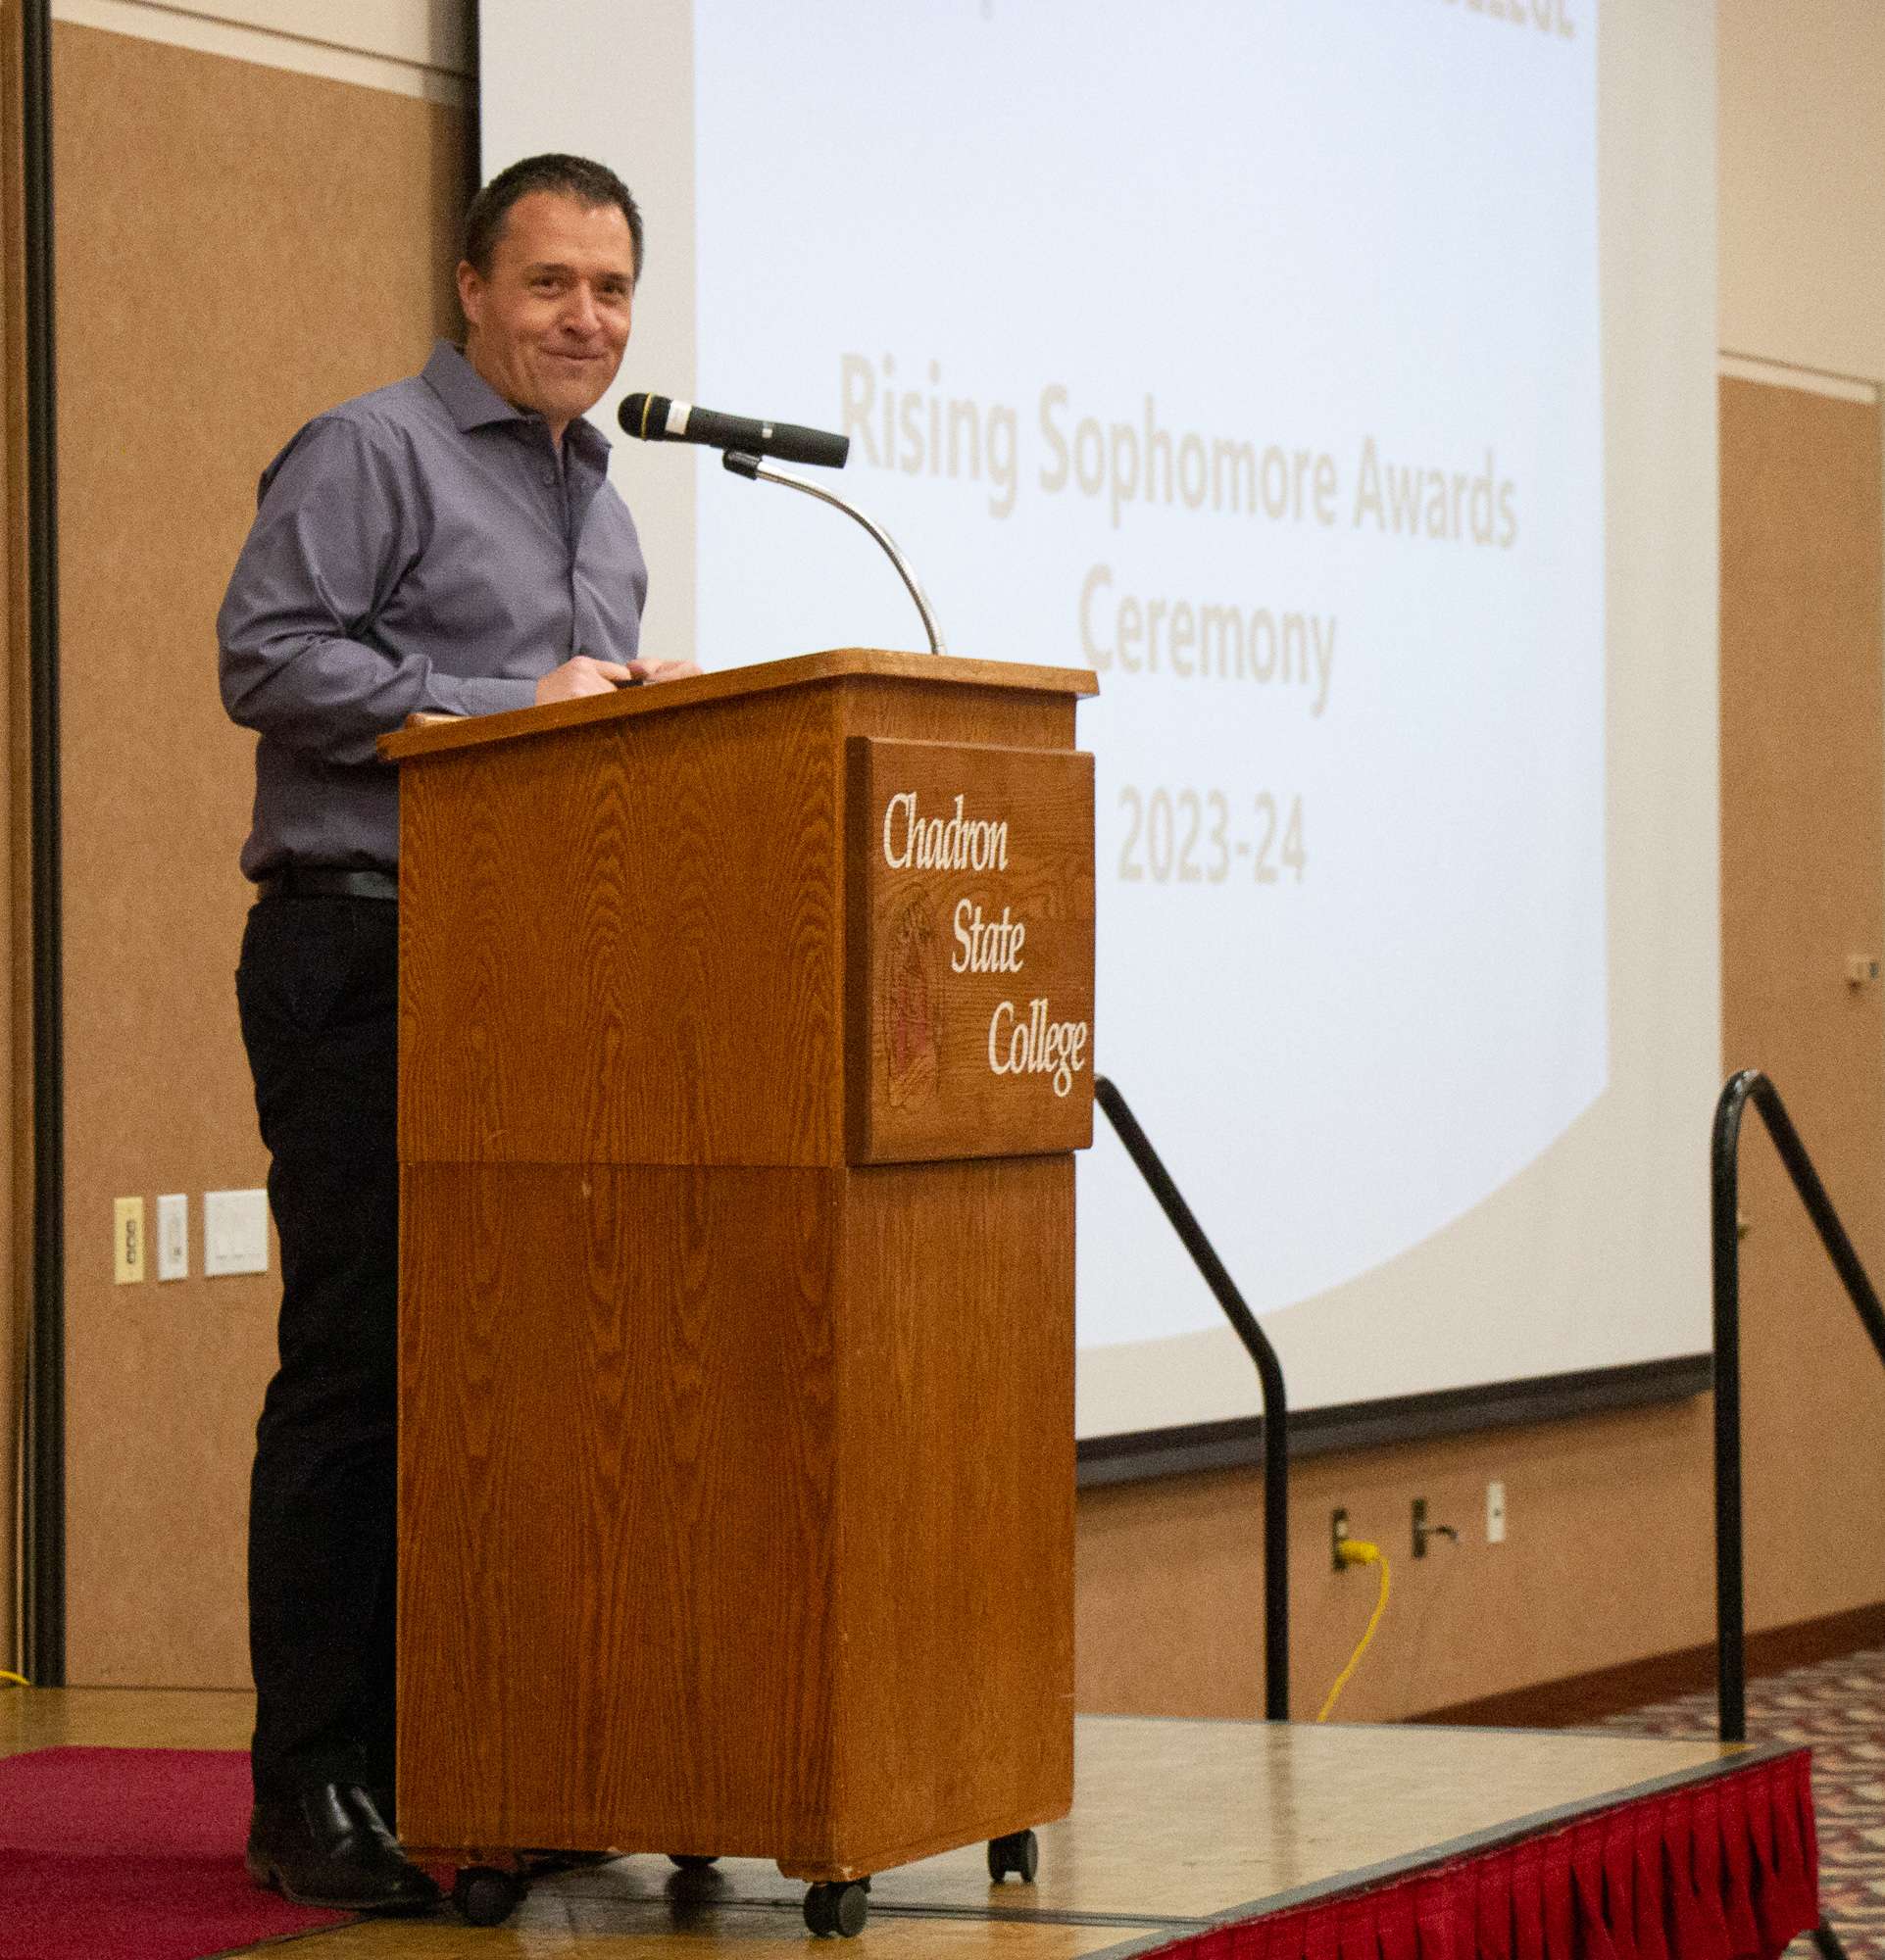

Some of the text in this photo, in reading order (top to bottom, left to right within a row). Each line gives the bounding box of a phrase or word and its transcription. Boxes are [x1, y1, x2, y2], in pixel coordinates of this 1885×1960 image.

[840, 353, 1519, 549] Rising Sophomore Awards
[1080, 564, 1337, 717] Ceremony
[883, 791, 1009, 872] Chadron
[1117, 786, 1307, 885] 2023-24
[951, 898, 1026, 973] State
[988, 998, 1088, 1098] College
